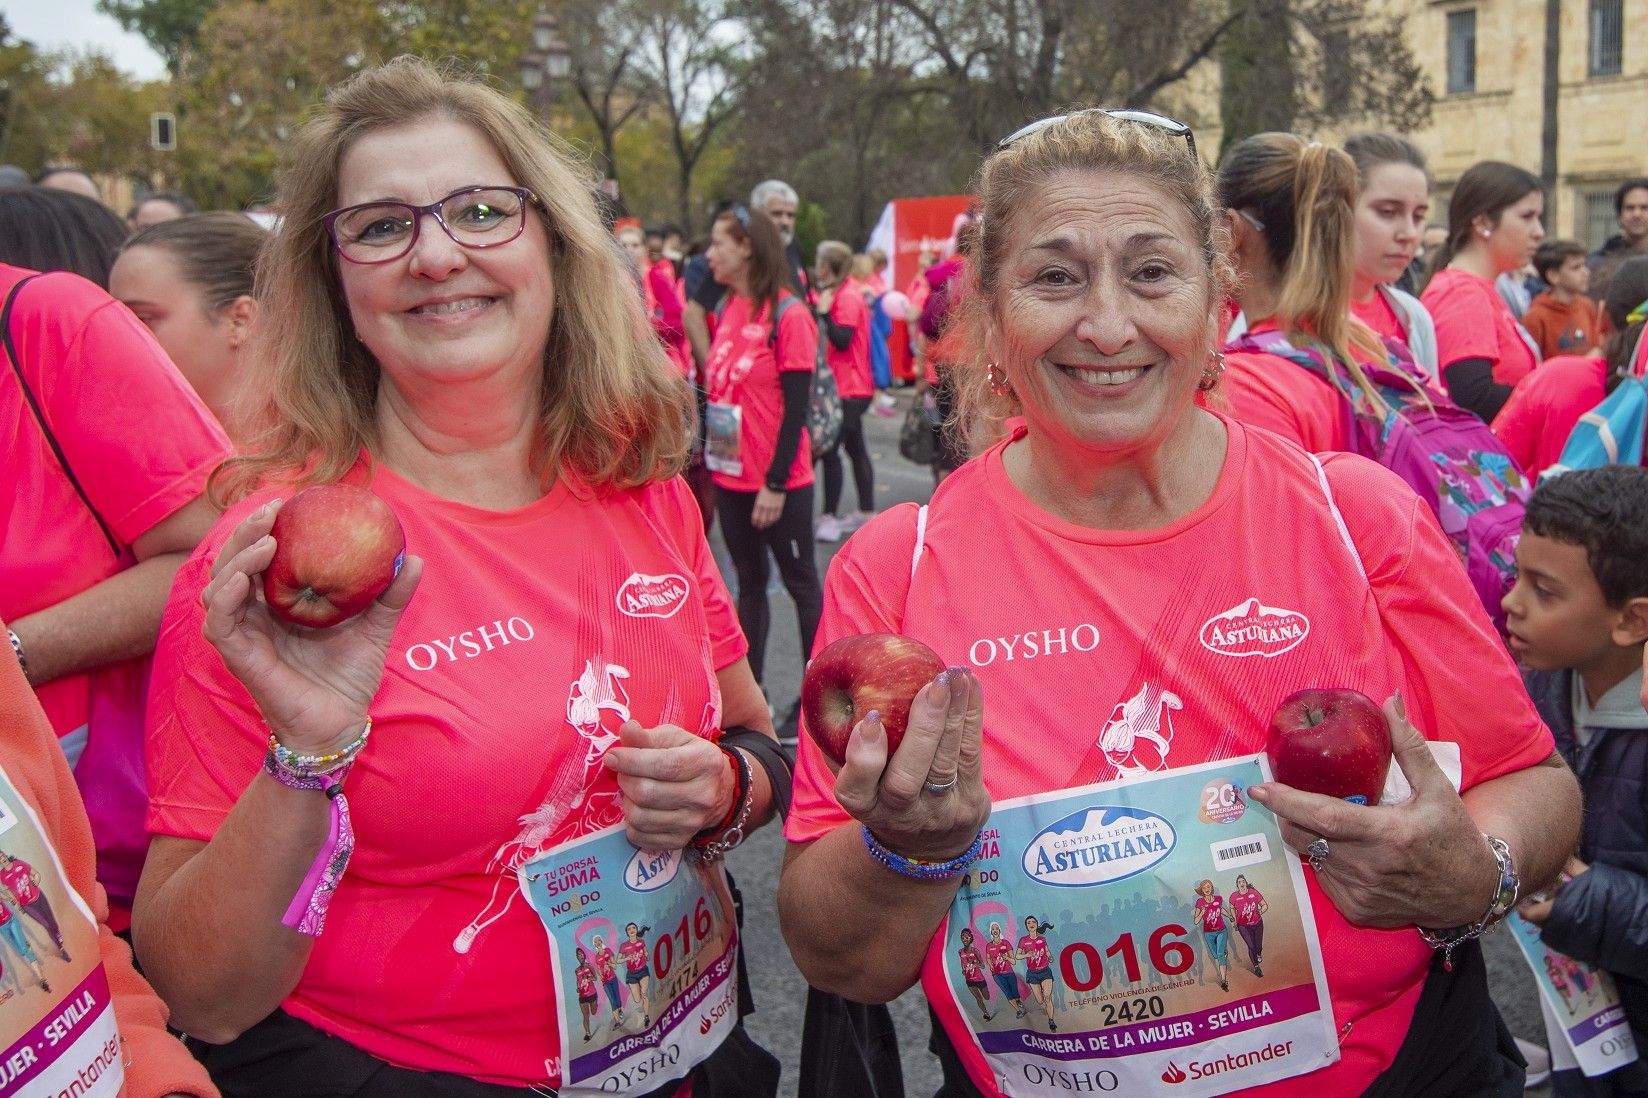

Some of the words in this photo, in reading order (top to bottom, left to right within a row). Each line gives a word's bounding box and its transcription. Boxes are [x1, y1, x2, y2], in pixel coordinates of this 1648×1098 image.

[405, 616, 535, 672] OYSHO
[969, 623, 1101, 667] OYSHO
[1034, 832, 1168, 876] ASTURIANA
[1053, 834, 1104, 850] CENTRAL
[1107, 821, 1158, 838] LECHERA
[544, 869, 557, 880] TU
[559, 855, 600, 876] DORSAL
[546, 866, 601, 897] SUMA
[653, 897, 712, 980] 016
[1059, 923, 1195, 992] 016
[609, 1024, 661, 1060] CARRERA
[661, 1014, 672, 1030] DE
[669, 1002, 684, 1018] LA
[684, 975, 711, 1007] MUJER
[1021, 1034, 1083, 1055] CARRERA
[1089, 1034, 1111, 1051] DE
[1114, 1031, 1135, 1049] LA
[1139, 1021, 1194, 1044] MUJER
[1207, 1000, 1274, 1030] SEVILLA
[1100, 995, 1165, 1026] 2420
[0, 1045, 39, 1090] UJER
[43, 989, 97, 1047] SEVILLA
[46, 1032, 119, 1098] antander
[601, 1043, 680, 1094] OYSHO
[1023, 1063, 1119, 1092] OYSHO
[1188, 1040, 1293, 1081] Santander
